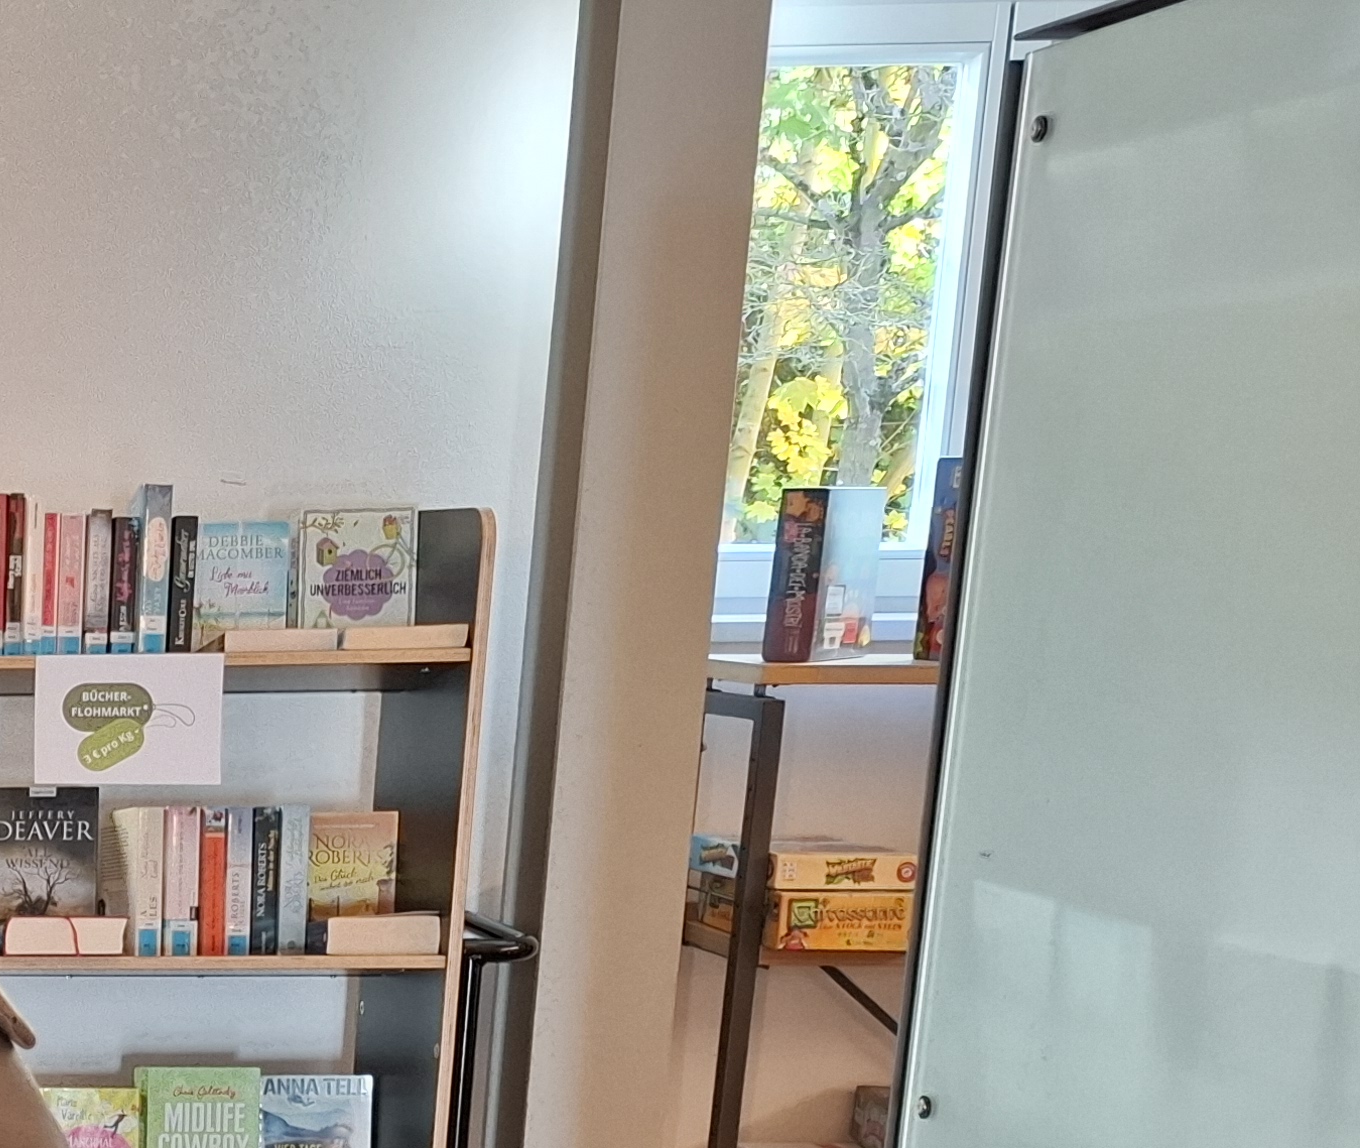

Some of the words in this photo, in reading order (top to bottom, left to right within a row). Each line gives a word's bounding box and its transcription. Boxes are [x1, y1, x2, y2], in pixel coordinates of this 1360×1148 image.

[207, 534, 265, 548] DEBBIE
[195, 546, 284, 561] MACOMBER
[335, 568, 383, 582] ZIEMLICH
[310, 581, 408, 597] UNVERBESSERLICH
[82, 688, 133, 702] BÜCHER-
[71, 706, 142, 719] FLOHMARKT
[83, 753, 93, 765] 3
[92, 748, 102, 760] €
[100, 739, 120, 757] pro
[118, 731, 135, 746] Kg
[10, 809, 76, 821] JEFFERY
[312, 833, 371, 852] NORA
[256, 842, 267, 887] ROBERTS
[256, 888, 266, 917] NORA
[262, 1076, 321, 1097] ANNA
[322, 1077, 368, 1097] TELL
[163, 1102, 246, 1134] MIDLIFE
